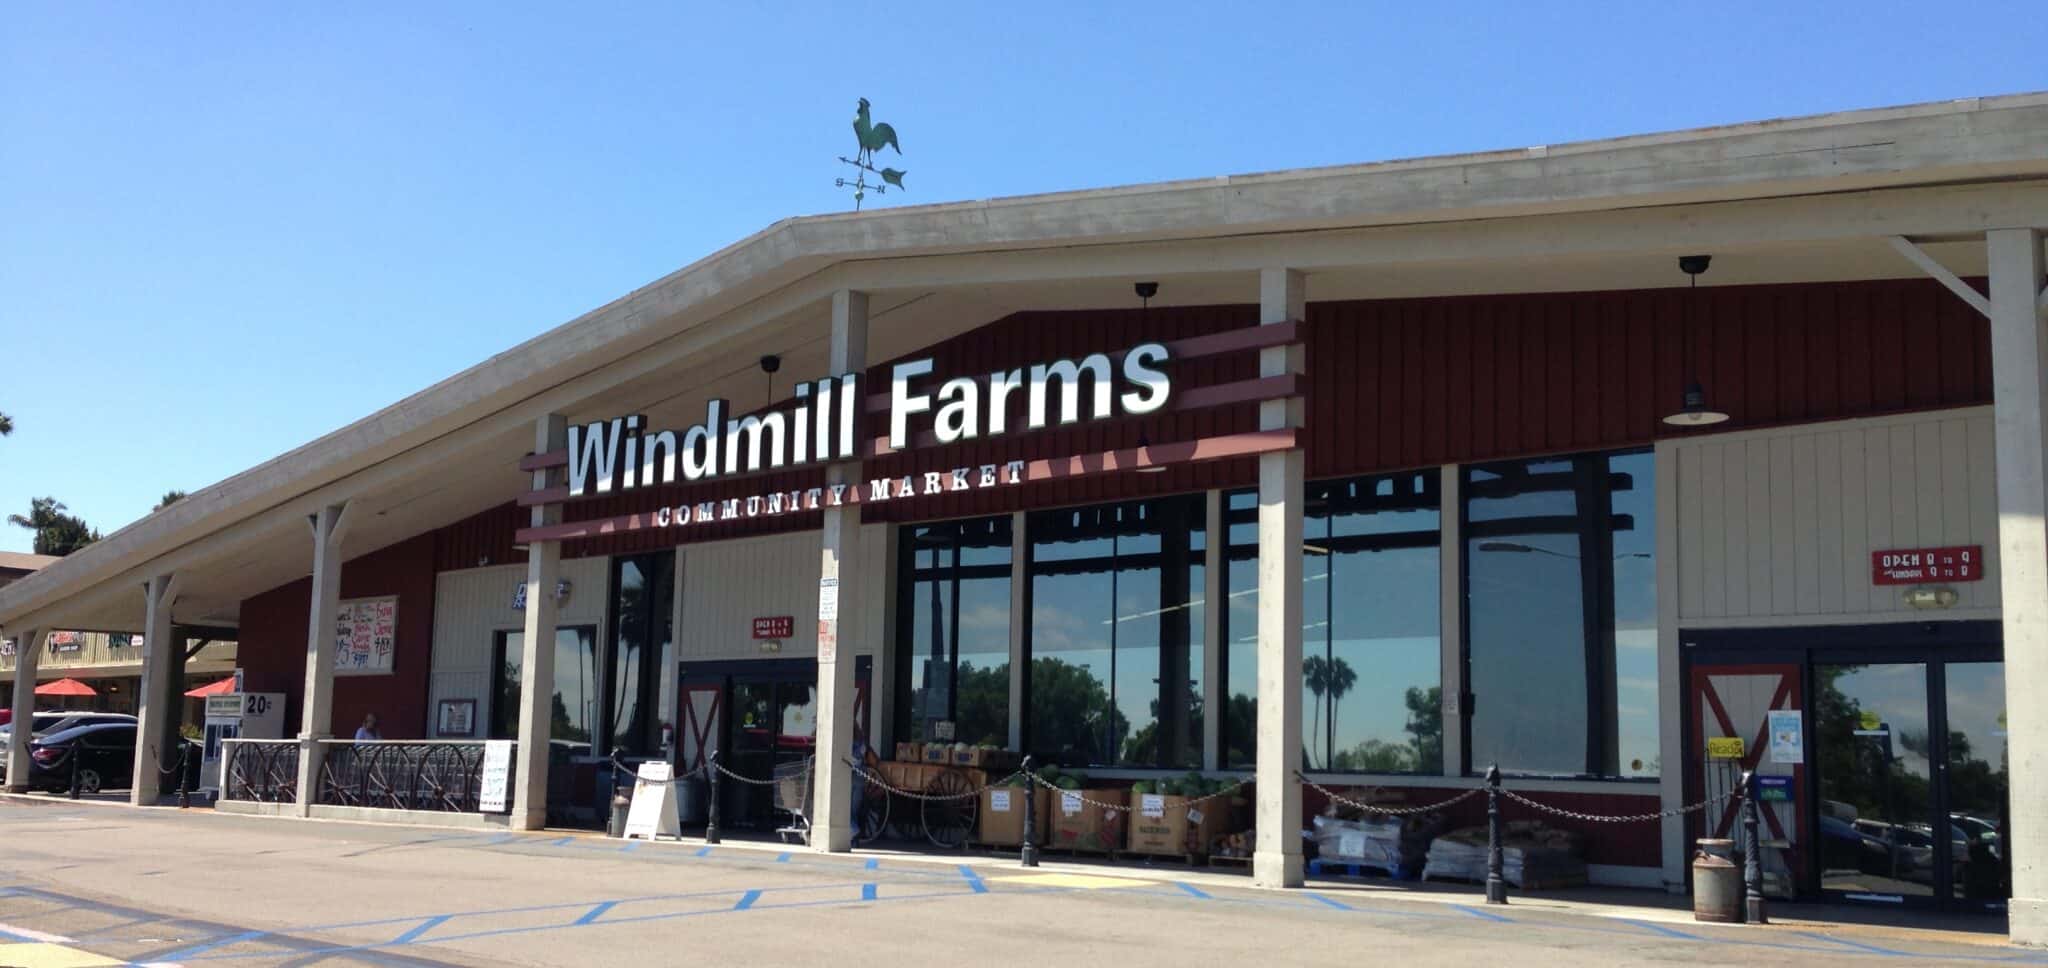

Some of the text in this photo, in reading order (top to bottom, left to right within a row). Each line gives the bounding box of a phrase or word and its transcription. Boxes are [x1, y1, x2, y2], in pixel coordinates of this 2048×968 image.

[567, 342, 1171, 496] Windmill Farms
[656, 460, 1025, 528] COMMUNITY MARKET
[1883, 554, 1920, 567] OPEN
[1961, 551, 1970, 563] 9
[1929, 565, 1937, 577] 9
